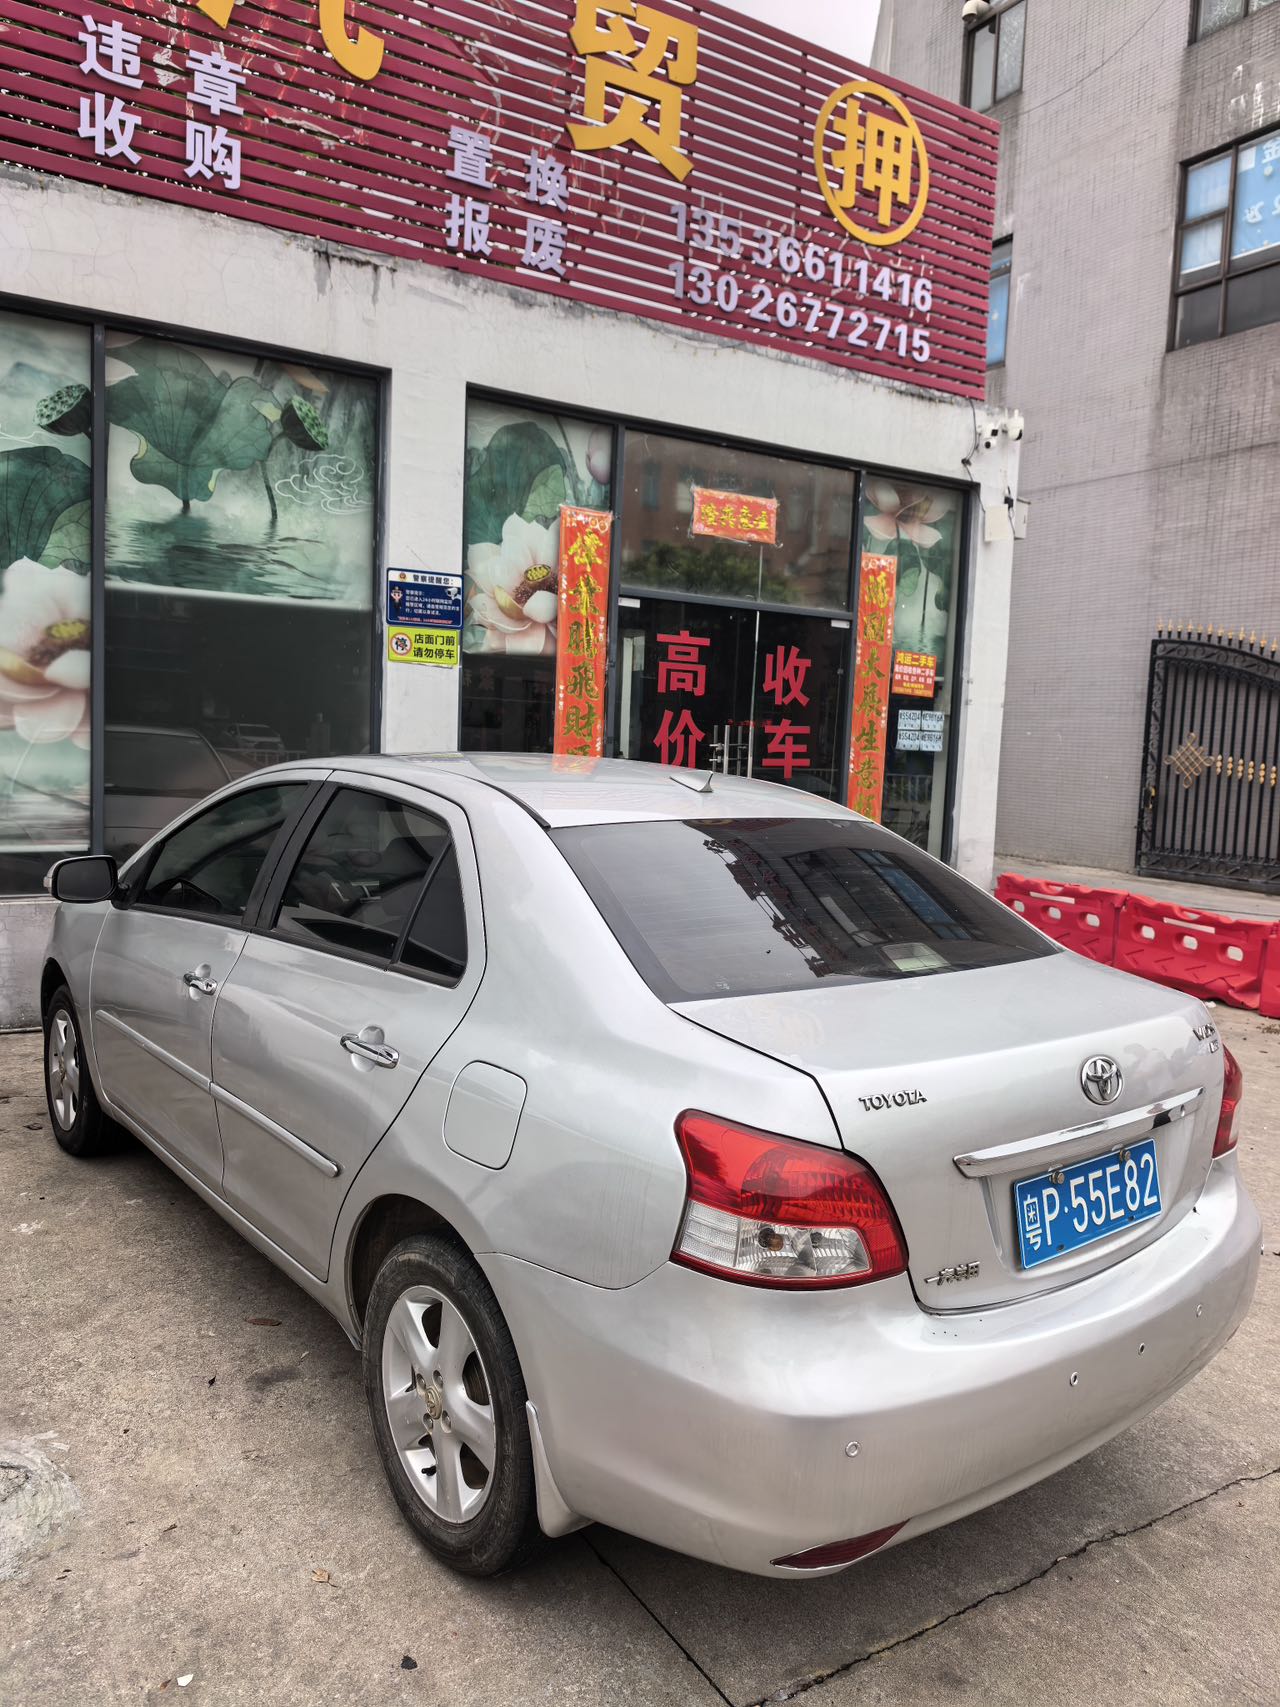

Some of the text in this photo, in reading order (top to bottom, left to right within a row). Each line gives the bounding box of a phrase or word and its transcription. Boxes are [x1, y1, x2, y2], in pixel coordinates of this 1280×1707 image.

[566, 0, 699, 182] 贸
[829, 98, 914, 227] 押
[414, 634, 455, 646] 店面门前
[413, 646, 455, 659] 请勿停车
[859, 1089, 928, 1112] TOYOTA
